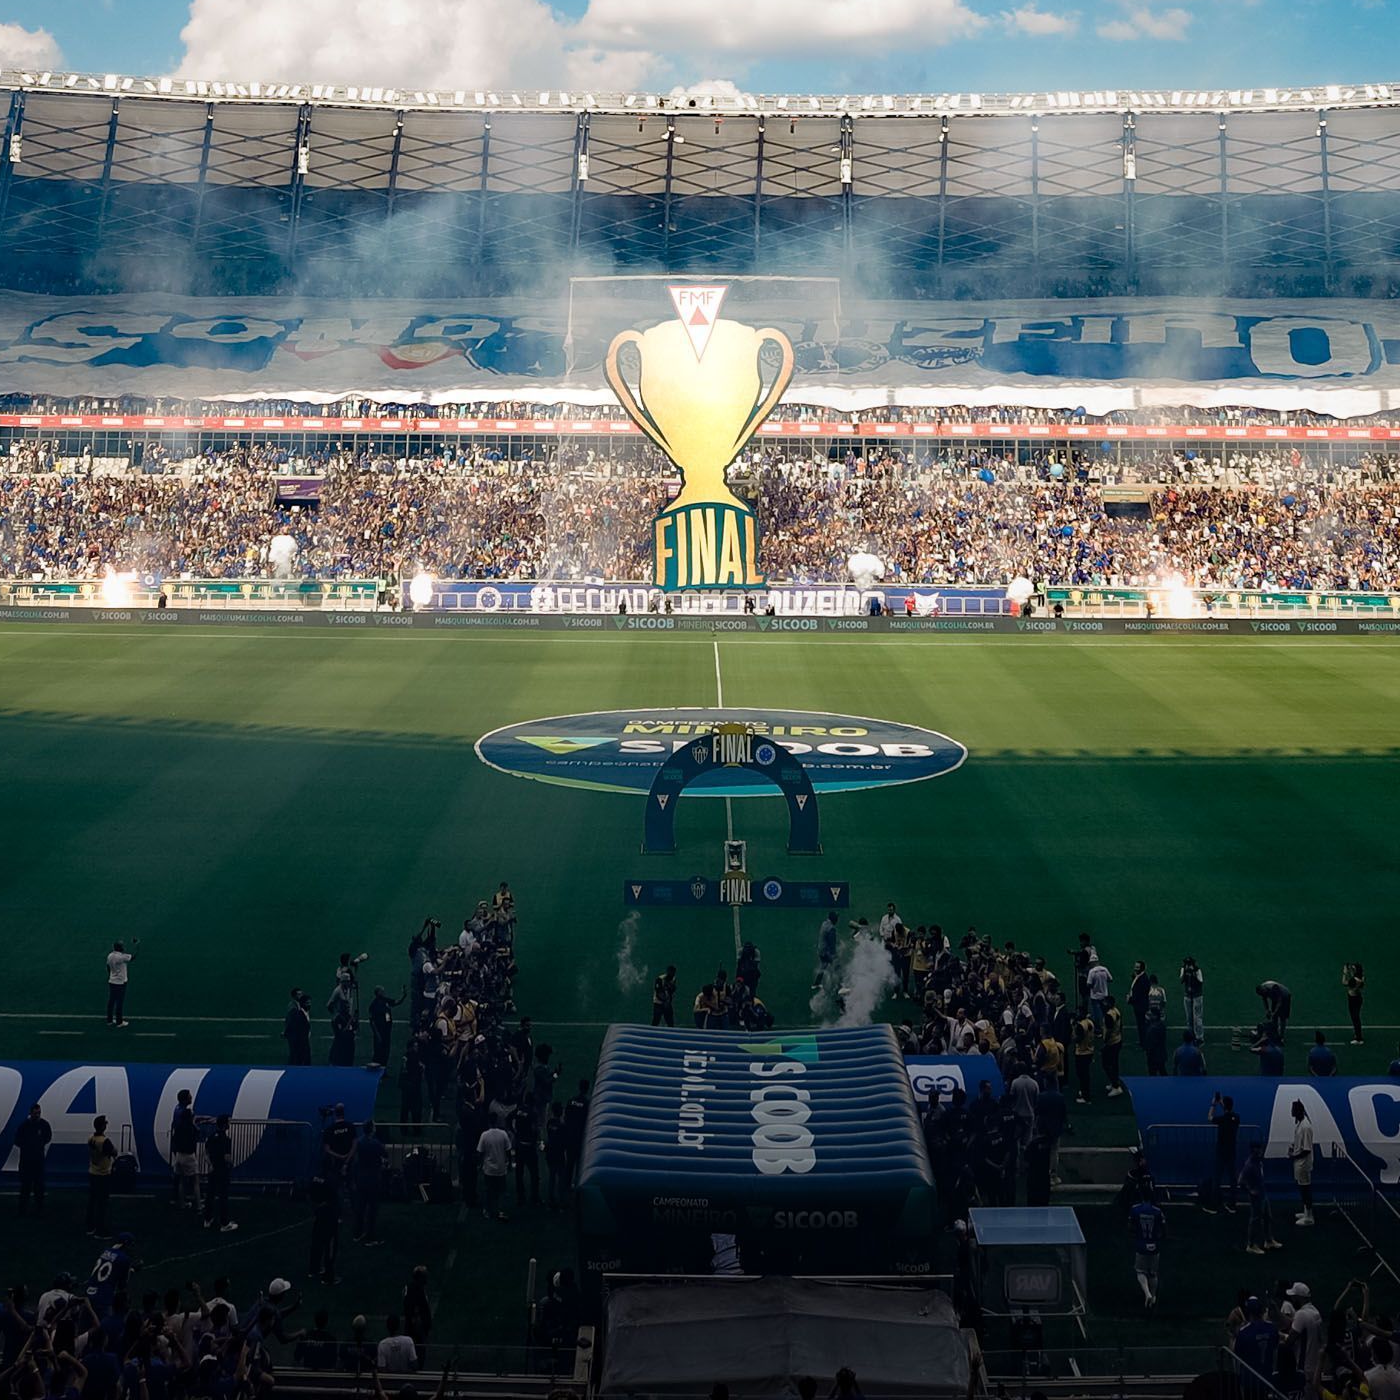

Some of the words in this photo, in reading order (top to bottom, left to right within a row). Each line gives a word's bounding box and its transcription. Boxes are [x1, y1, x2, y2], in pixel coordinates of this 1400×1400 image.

[678, 290, 716, 306] FMF
[654, 507, 765, 587] FINAL
[100, 611, 131, 621] SICOOB
[147, 612, 178, 621] SICOOB
[335, 614, 367, 624] SICOOB
[382, 615, 413, 625] SICOOB
[571, 618, 602, 628] SICOOB
[627, 618, 675, 630] SICOOB
[715, 620, 747, 630] SICOOB
[771, 619, 818, 631] SICOOB
[837, 620, 868, 630] SICOOB
[1025, 621, 1056, 630] SICOOB
[1072, 622, 1103, 631] SICOOB
[1260, 622, 1291, 631] SICOOB
[1306, 622, 1337, 631] SICOOB
[712, 734, 754, 763] FINAL
[720, 879, 753, 903] FINAL
[652, 1197, 709, 1208] CAMPEONATO
[653, 1208, 737, 1227] MINEIRO
[773, 1210, 859, 1230] SICOOB
